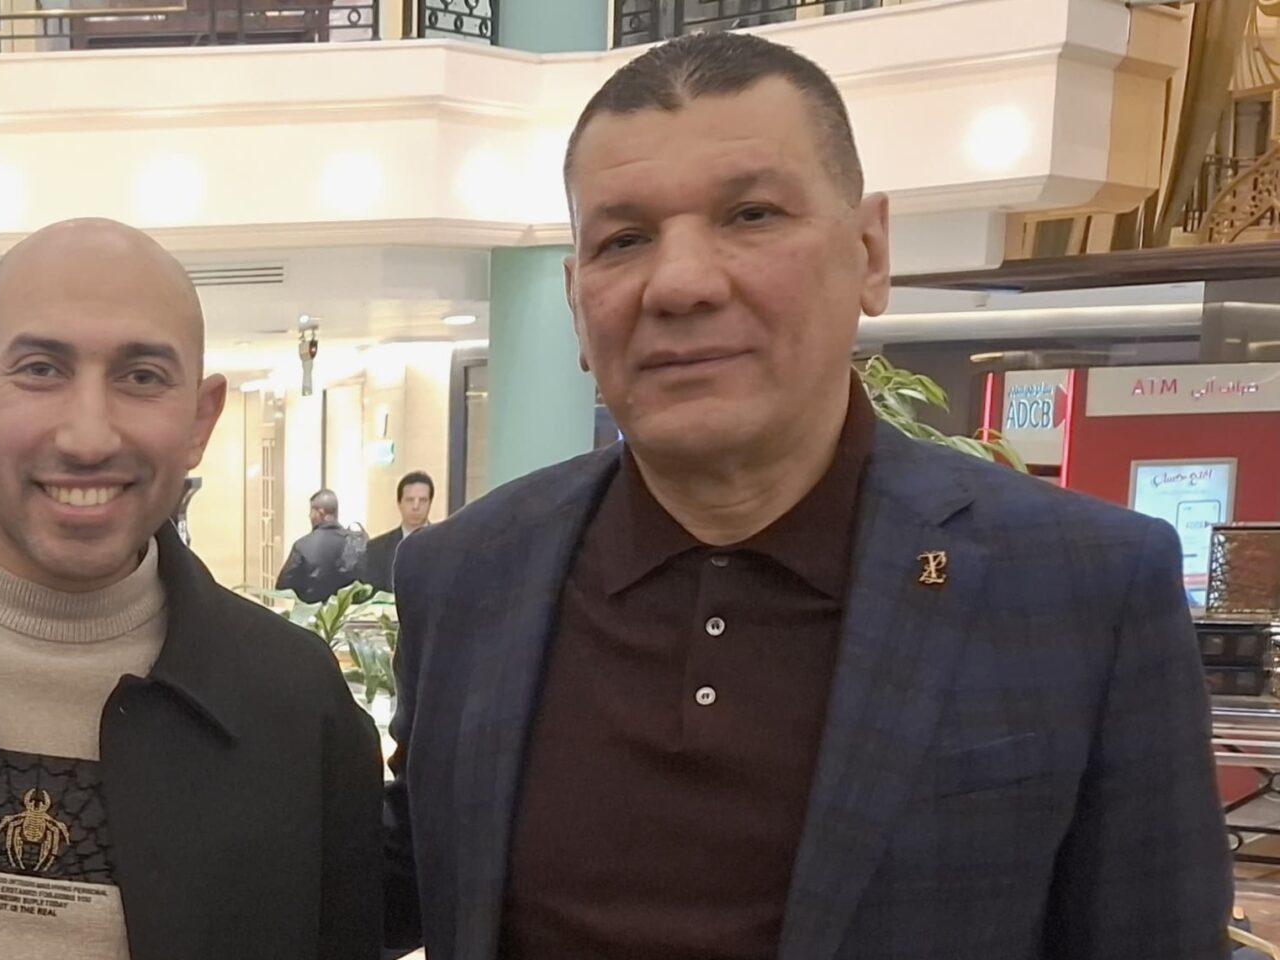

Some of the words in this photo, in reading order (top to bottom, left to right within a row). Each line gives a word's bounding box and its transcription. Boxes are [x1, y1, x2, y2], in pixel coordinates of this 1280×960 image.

[1131, 377, 1178, 397] ATM
[1006, 399, 1053, 429] ADCB
[20, 905, 35, 915] THE
[37, 907, 57, 917] REAL
